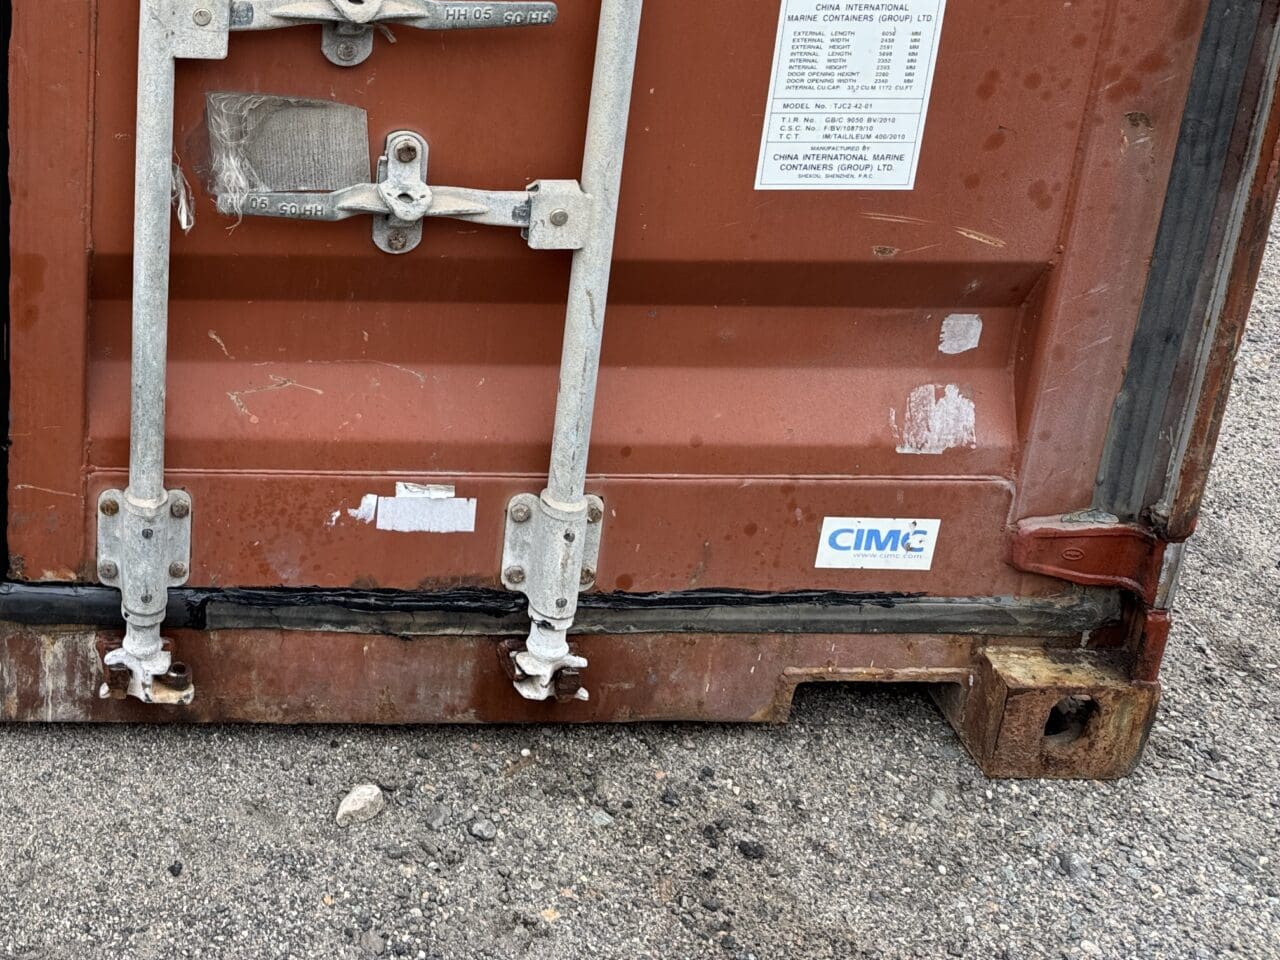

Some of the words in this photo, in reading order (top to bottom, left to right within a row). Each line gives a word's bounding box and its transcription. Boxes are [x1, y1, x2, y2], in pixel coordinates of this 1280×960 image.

[445, 8, 467, 21] HH
[473, 6, 493, 20] 05
[787, 14, 818, 22] MARINE
[823, 14, 874, 22] CONTAINERS
[878, 14, 913, 23] (GROUP)
[837, 164, 873, 172] (GROUP)
[828, 528, 927, 552] CIMC
